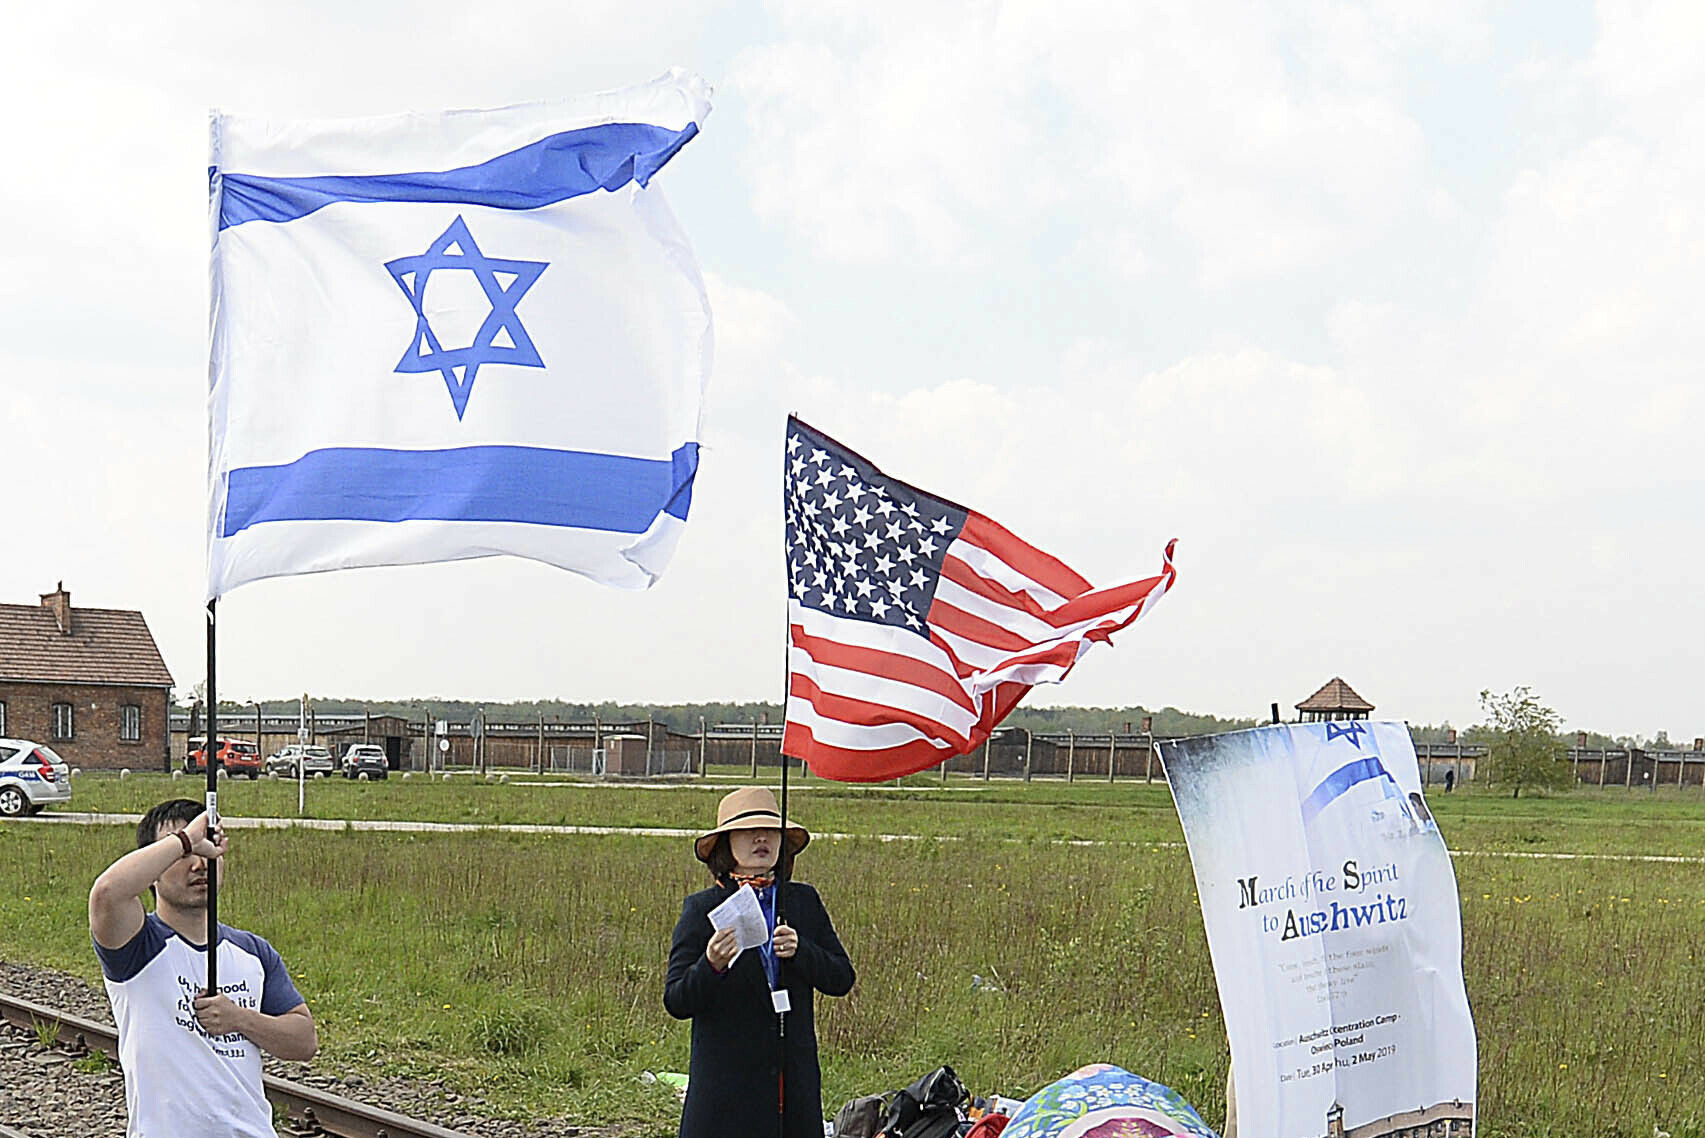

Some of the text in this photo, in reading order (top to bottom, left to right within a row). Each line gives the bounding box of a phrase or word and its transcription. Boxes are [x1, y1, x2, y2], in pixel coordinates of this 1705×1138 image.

[1238, 876, 1295, 909] March
[1343, 860, 1398, 893] Spirit
[1263, 914, 1279, 933] to
[1334, 1034, 1364, 1048] Poland
[1358, 1050, 1377, 1064] May
